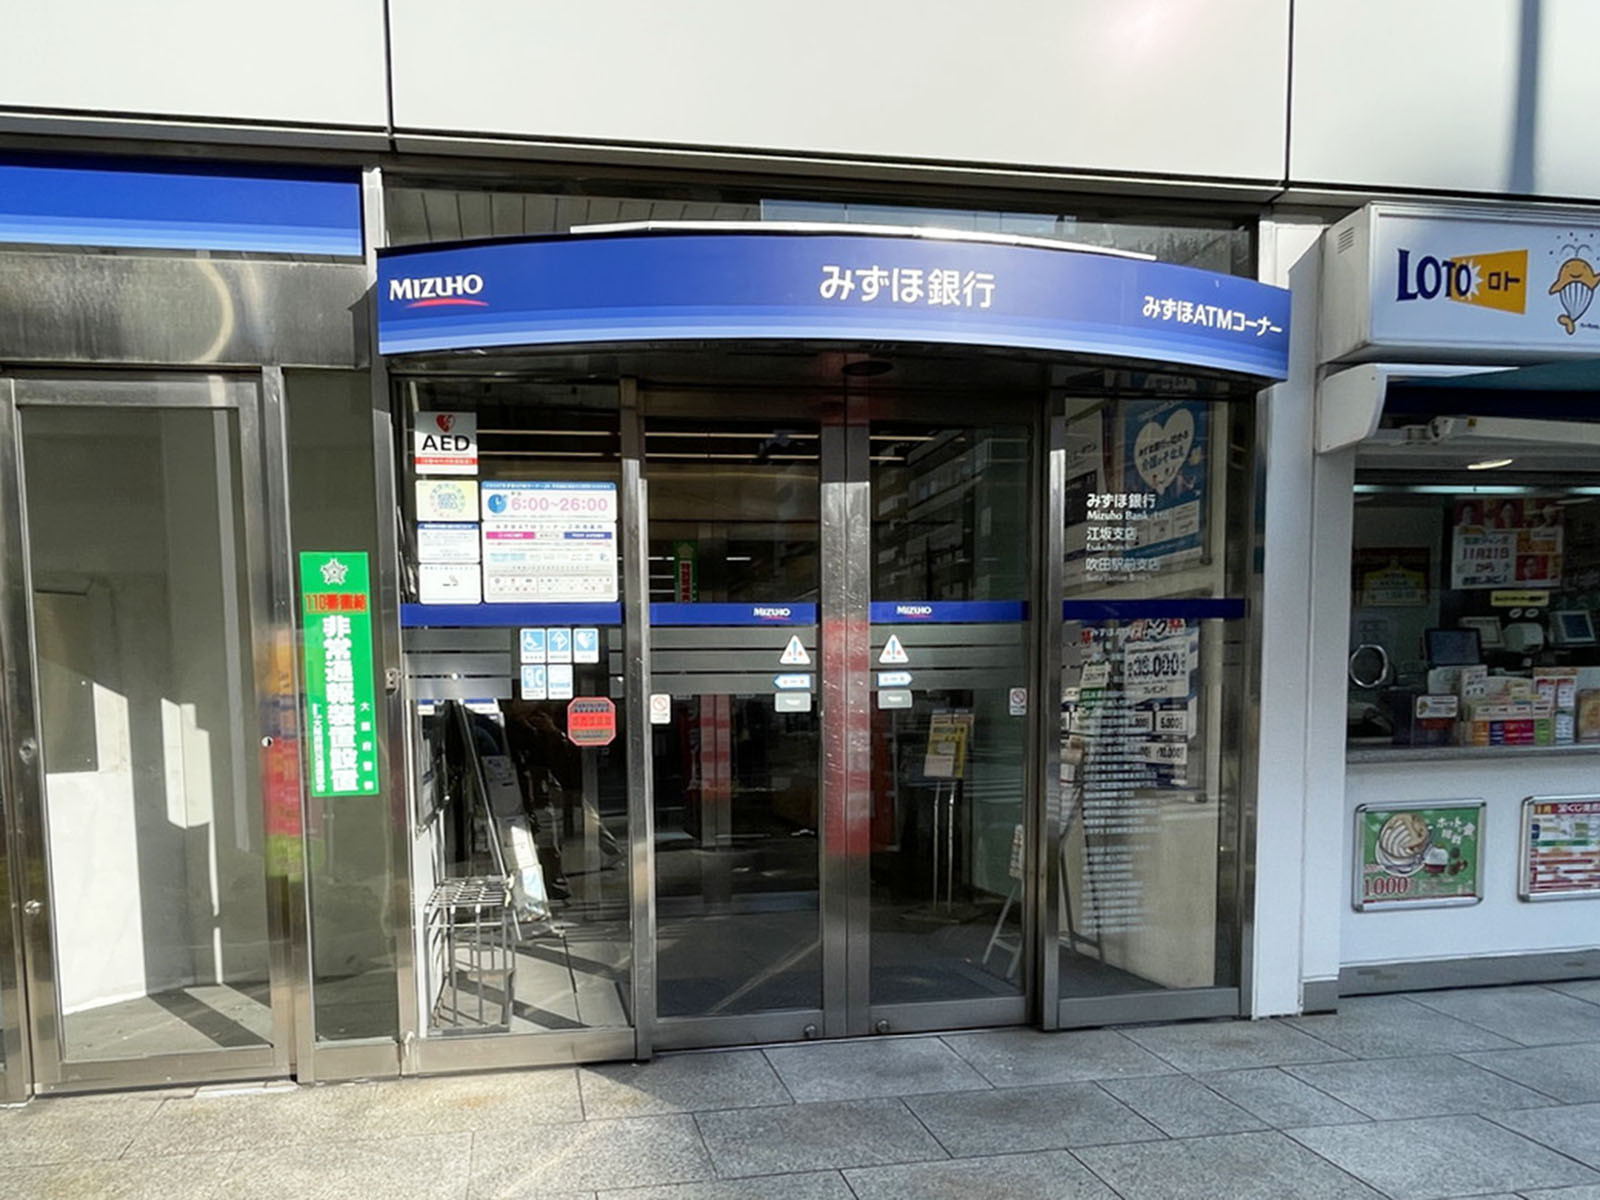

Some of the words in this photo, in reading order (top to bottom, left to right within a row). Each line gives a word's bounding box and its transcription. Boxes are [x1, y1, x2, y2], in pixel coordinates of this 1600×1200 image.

[1396, 248, 1471, 301] LOTO
[389, 273, 484, 301] MIZUHO
[819, 264, 995, 309] みずほ銀行
[1142, 294, 1283, 338] みずほATMコーナー
[422, 434, 470, 452] AED
[1086, 493, 1157, 509] みずほ銀行
[1086, 510, 1123, 520] Mizuho
[1086, 526, 1137, 541] 江坂支店
[1462, 546, 1510, 560] 11月21日
[1085, 557, 1160, 572] 吹田駅前支店
[753, 606, 791, 617] MIZUHO
[896, 605, 933, 616] MIZUHO
